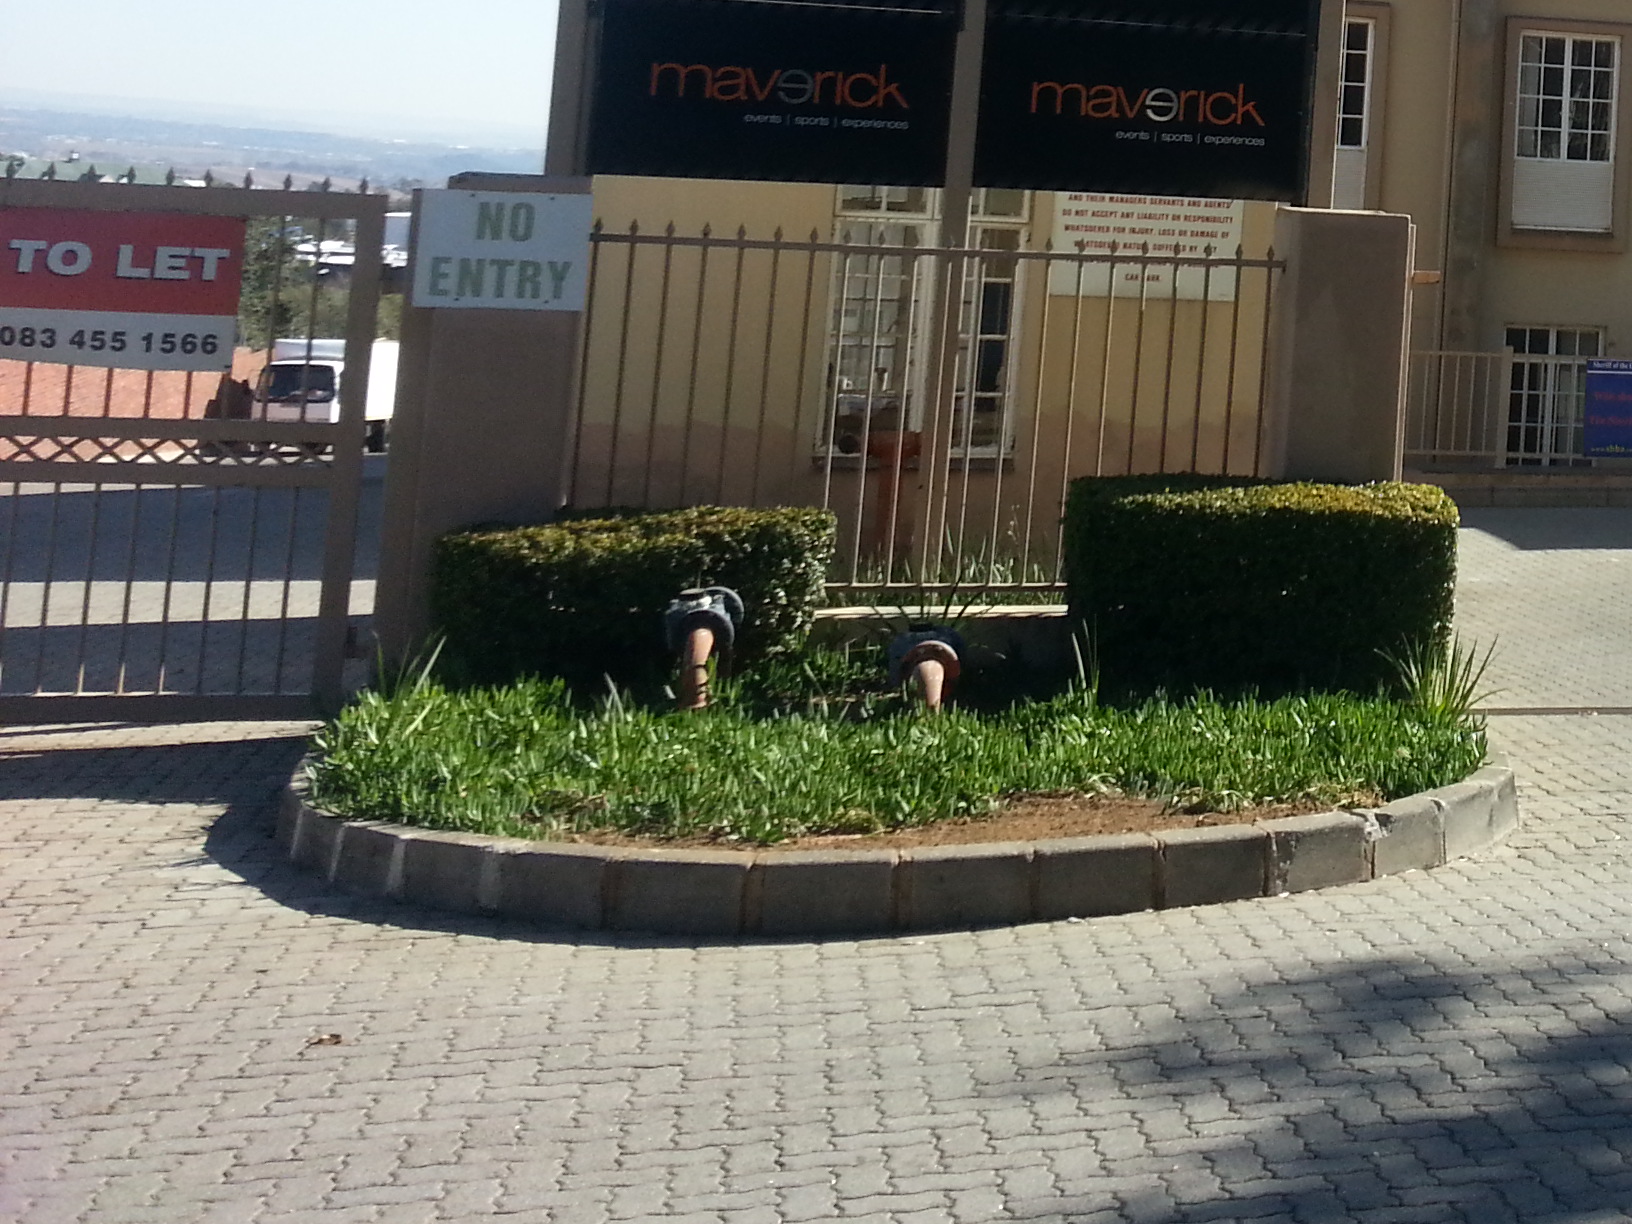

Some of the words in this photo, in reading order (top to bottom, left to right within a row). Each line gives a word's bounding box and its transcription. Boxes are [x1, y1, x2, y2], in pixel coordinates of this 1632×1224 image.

[649, 62, 910, 109] maverick
[1029, 81, 1266, 126] maverick
[743, 113, 783, 125] events
[793, 115, 830, 127] sports
[840, 117, 910, 131] experiences
[1115, 129, 1150, 141] events
[1161, 131, 1193, 144] sports
[1203, 133, 1266, 147] experiences
[475, 200, 536, 242] NO
[1091, 210, 1118, 218] ACCEPT
[9, 239, 93, 276] TO
[115, 243, 231, 281] LET
[428, 256, 574, 300] ENTRY
[0, 326, 57, 349] 083
[69, 328, 128, 353] 455
[141, 331, 219, 356] 1566
